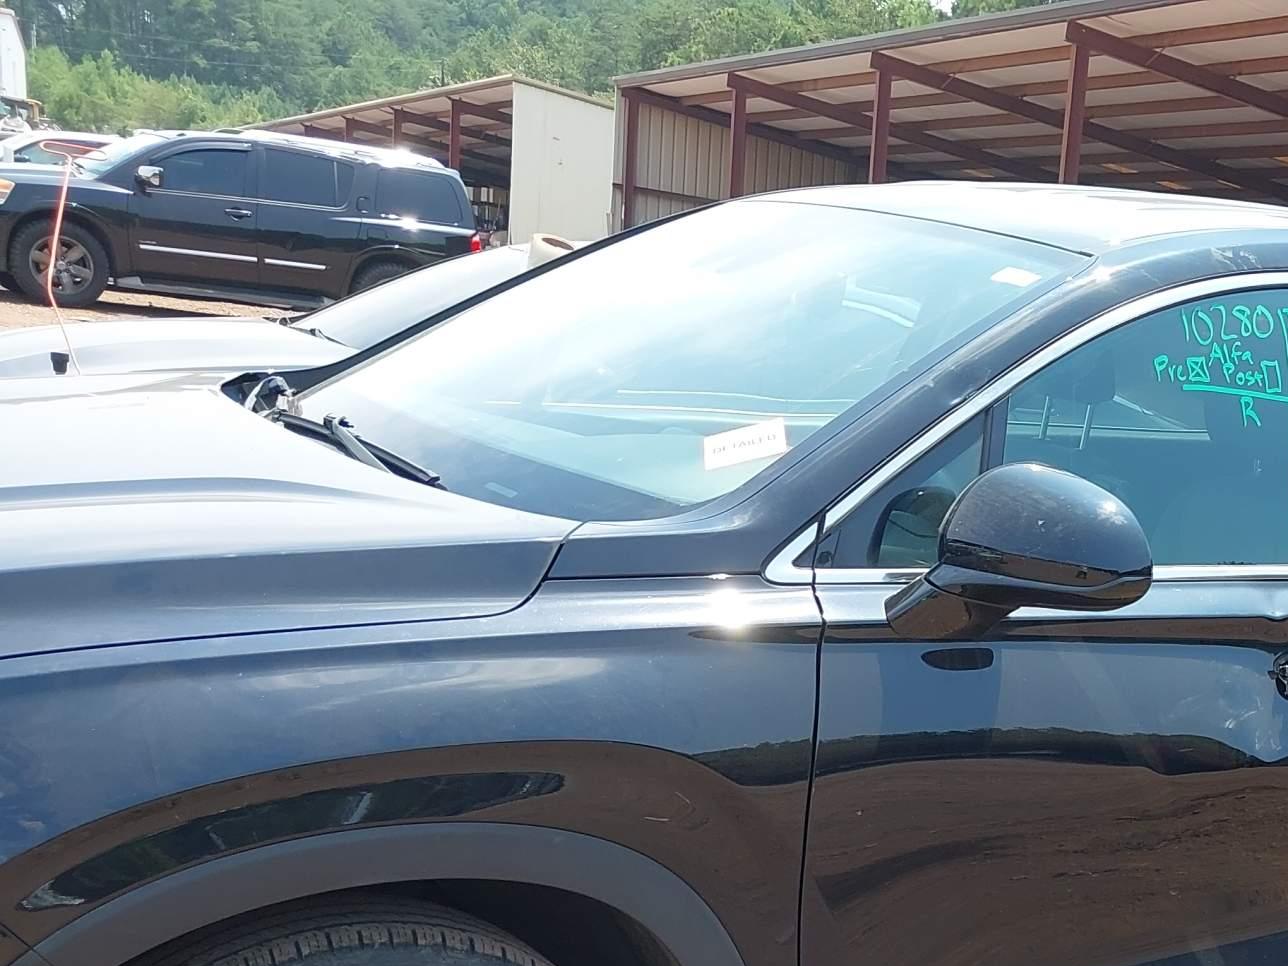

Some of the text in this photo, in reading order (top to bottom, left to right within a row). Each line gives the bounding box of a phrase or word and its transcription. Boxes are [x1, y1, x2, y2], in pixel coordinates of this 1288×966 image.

[1182, 304, 1273, 345] 10280
[1153, 355, 1264, 387] Pre Post
[1240, 396, 1261, 427] R
